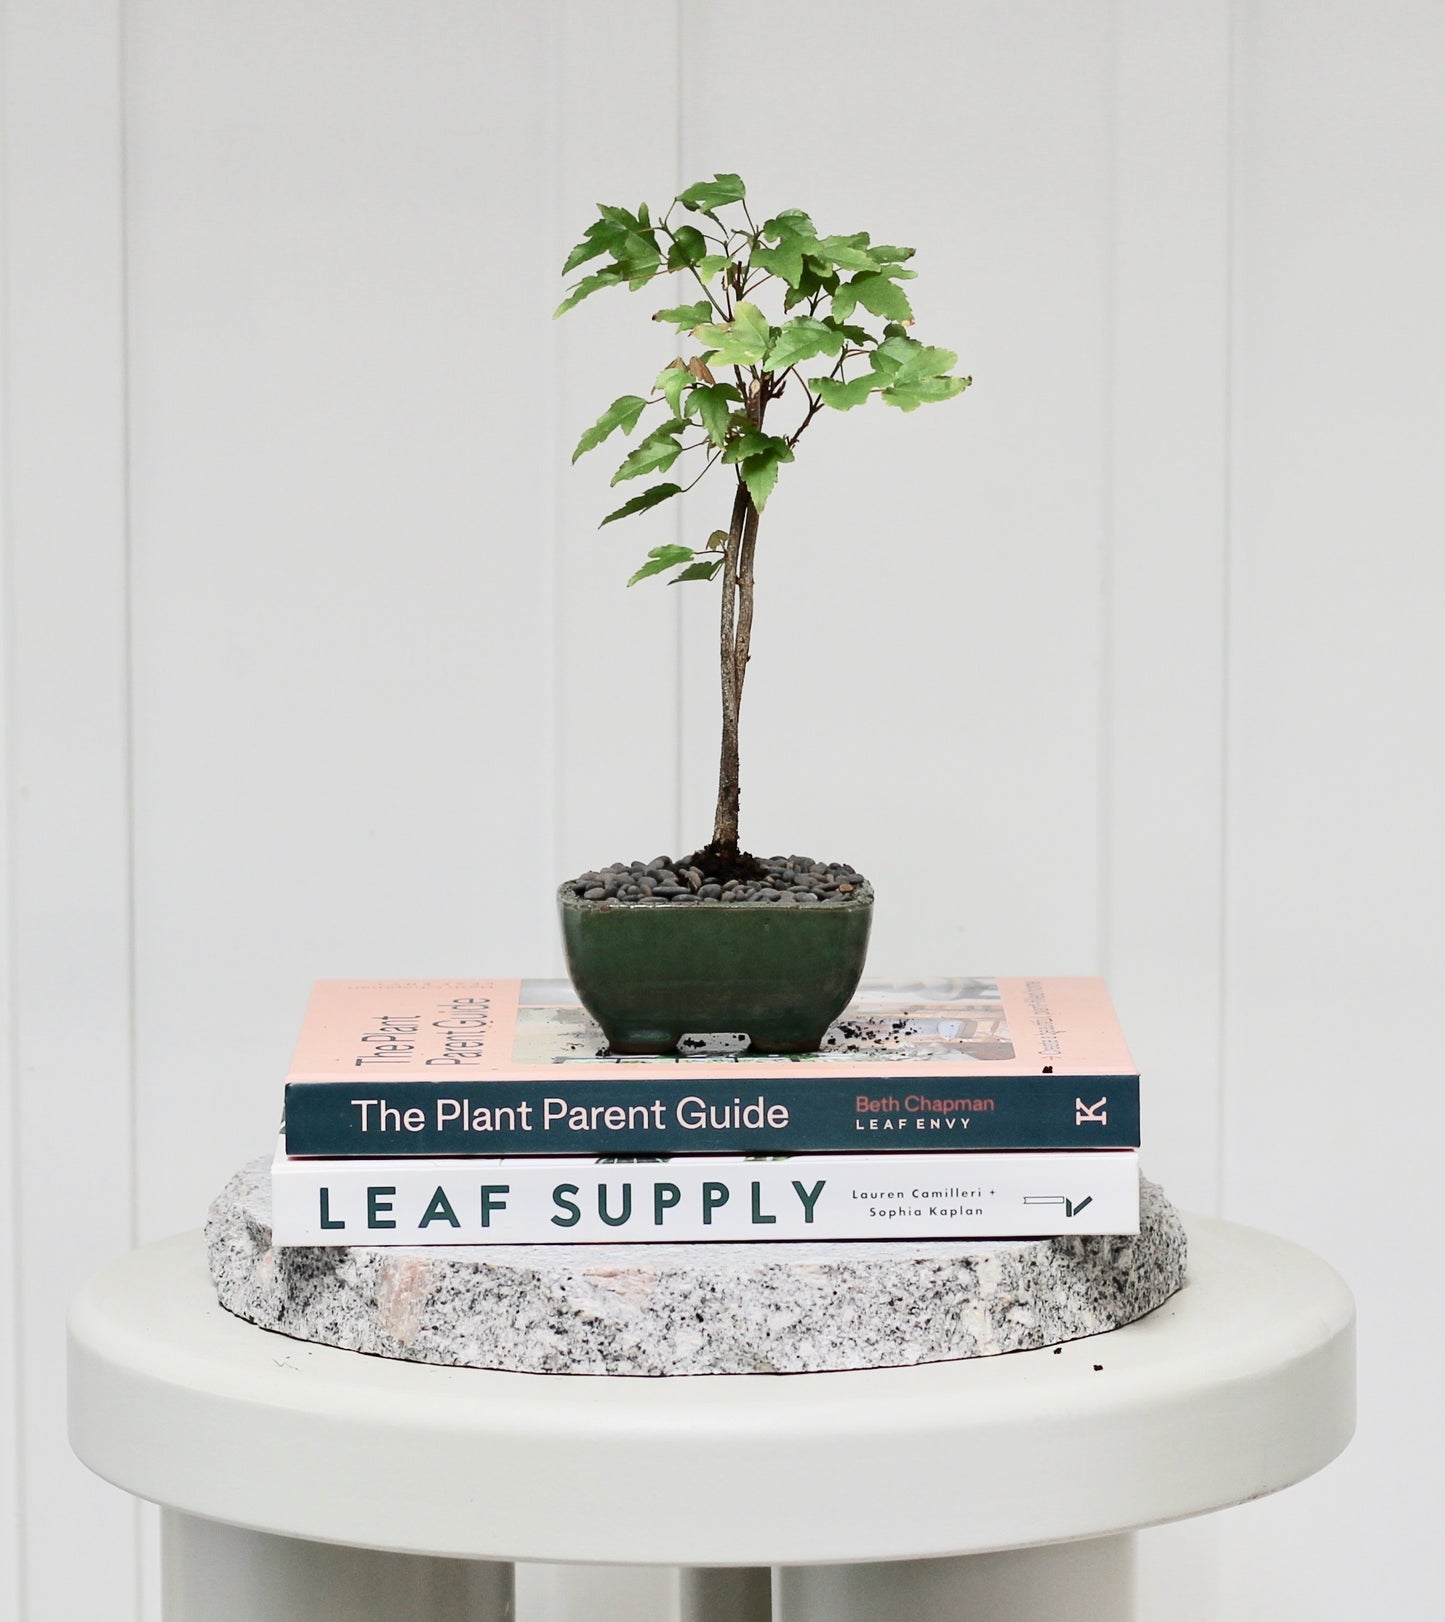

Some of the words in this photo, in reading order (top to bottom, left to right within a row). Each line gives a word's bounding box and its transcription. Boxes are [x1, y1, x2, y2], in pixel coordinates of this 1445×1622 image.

[432, 998, 491, 1029] Guide
[361, 1015, 420, 1042] Plant
[355, 1044, 414, 1066] The
[425, 1030, 486, 1065] Parent
[351, 1099, 425, 1131] The
[436, 1098, 532, 1131] Plant
[543, 1097, 666, 1130] Parent
[676, 1095, 789, 1129] Guide
[856, 1096, 899, 1112] Beth
[904, 1095, 994, 1116] Chapman
[1075, 1096, 1107, 1126] K
[856, 1119, 907, 1130] LEAF
[916, 1118, 970, 1129] ENVY
[319, 1184, 510, 1230] LEAF
[550, 1179, 827, 1228] SUPPLY
[852, 1189, 904, 1200] Lauren
[911, 1188, 982, 1199] Camilleri
[869, 1206, 922, 1220] Sophia
[929, 1205, 983, 1219] Kaplan
